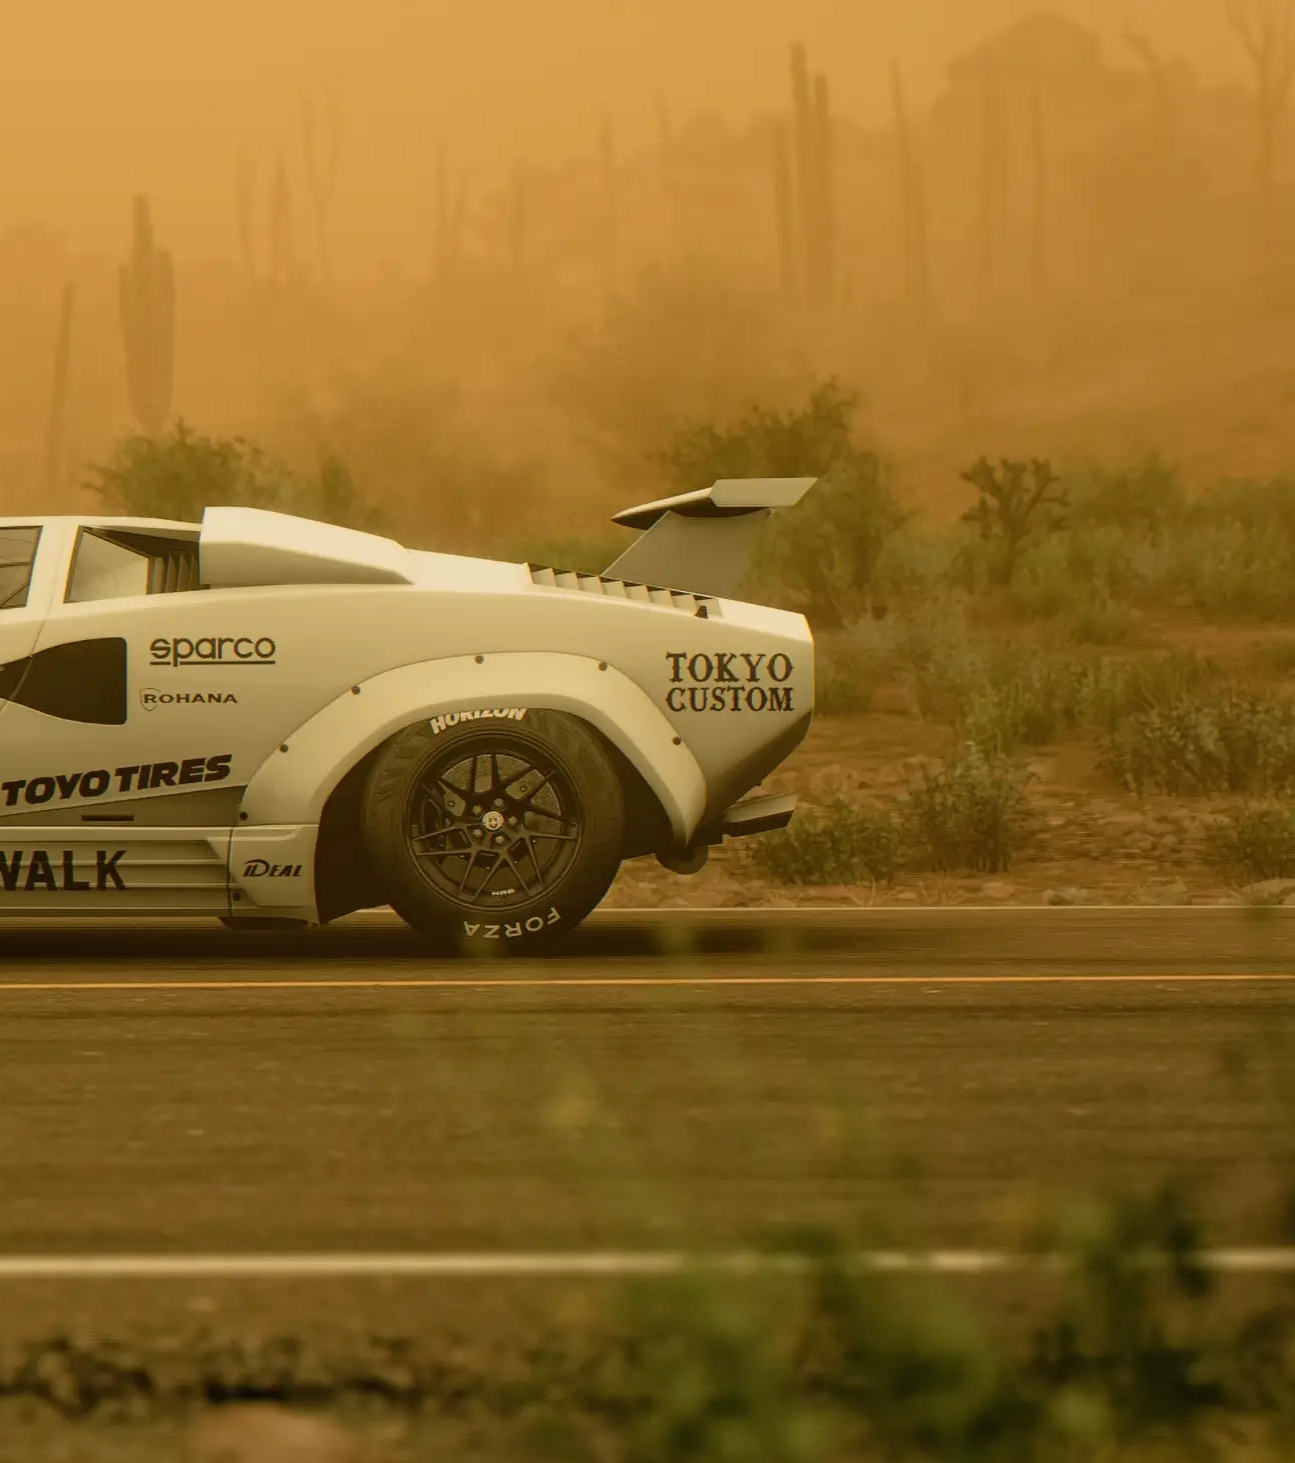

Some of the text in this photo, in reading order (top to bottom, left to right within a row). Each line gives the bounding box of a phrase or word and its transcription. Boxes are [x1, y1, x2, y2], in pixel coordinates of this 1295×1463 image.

[149, 637, 276, 667] sparco
[665, 652, 794, 682] TOKYO
[143, 693, 238, 704] ROHANA
[665, 685, 794, 712] CUSTOM
[1, 754, 233, 806] TOYO TIRES
[463, 907, 561, 938] FORZA
